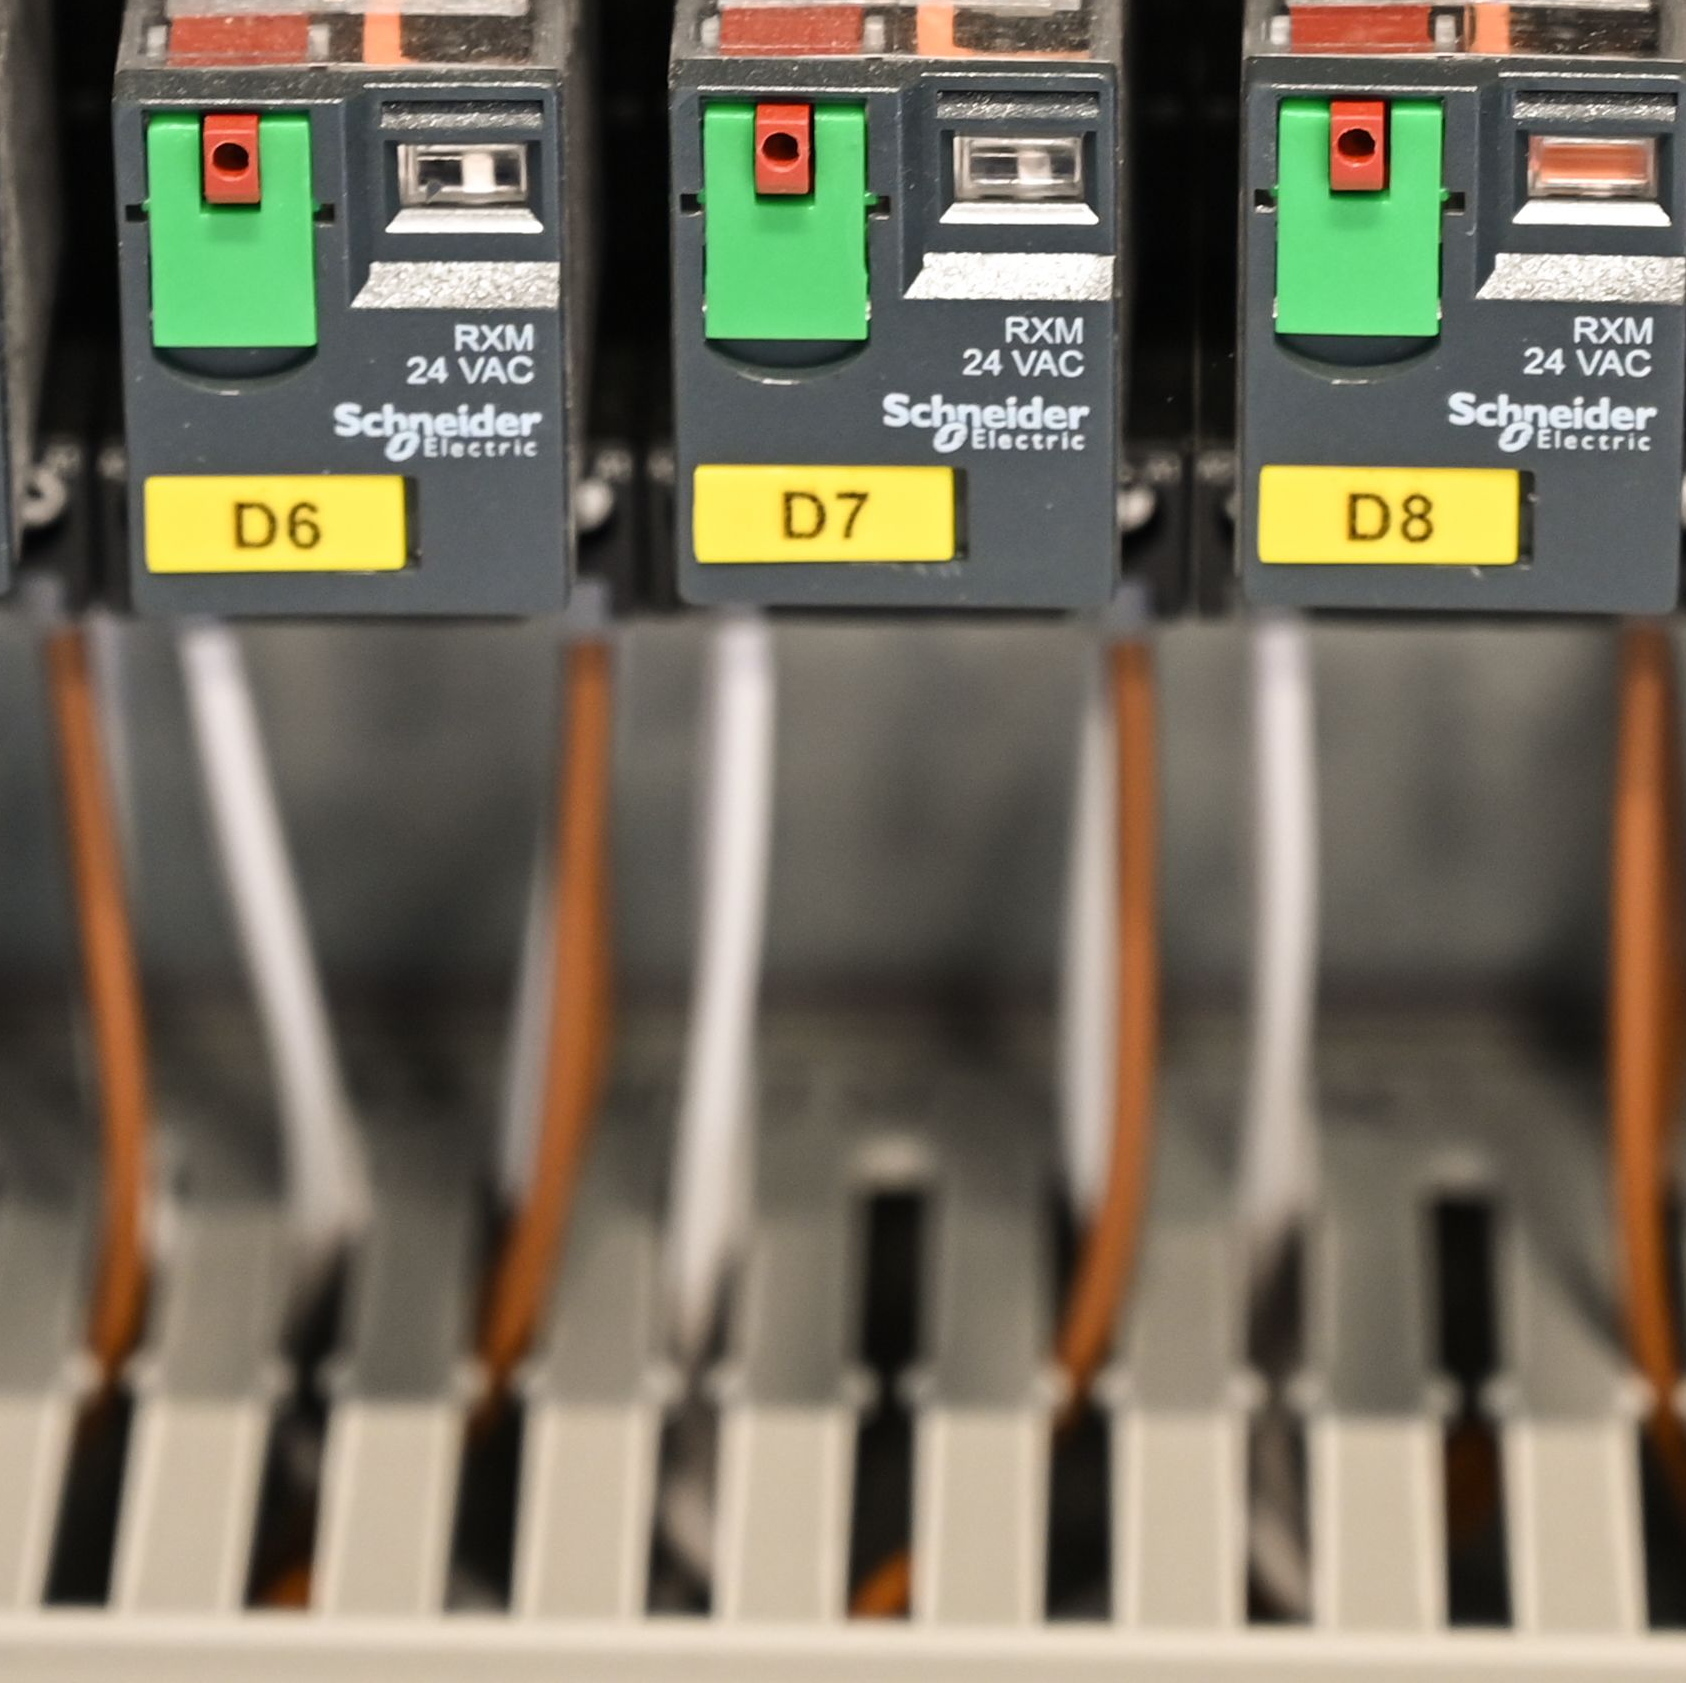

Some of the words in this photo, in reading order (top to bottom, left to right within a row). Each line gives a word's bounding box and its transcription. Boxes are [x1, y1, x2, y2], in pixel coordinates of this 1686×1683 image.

[455, 324, 534, 351] RXM
[1005, 316, 1083, 344] RXM
[1574, 316, 1653, 344] RXM
[407, 356, 449, 384] 24
[458, 355, 534, 384] VAC
[963, 348, 1003, 376] 24
[1011, 350, 1084, 377] VAC
[1523, 347, 1565, 375] 24
[1576, 349, 1651, 377] VAC
[334, 402, 543, 439] Schneider
[883, 393, 1090, 429] Schneider
[1448, 392, 1657, 429] Schneider
[423, 434, 537, 457] Electric
[972, 427, 1084, 450] Electric
[1537, 426, 1650, 451] Electric
[233, 502, 321, 550] D6
[783, 491, 869, 539] D7
[1347, 493, 1433, 543] D8
